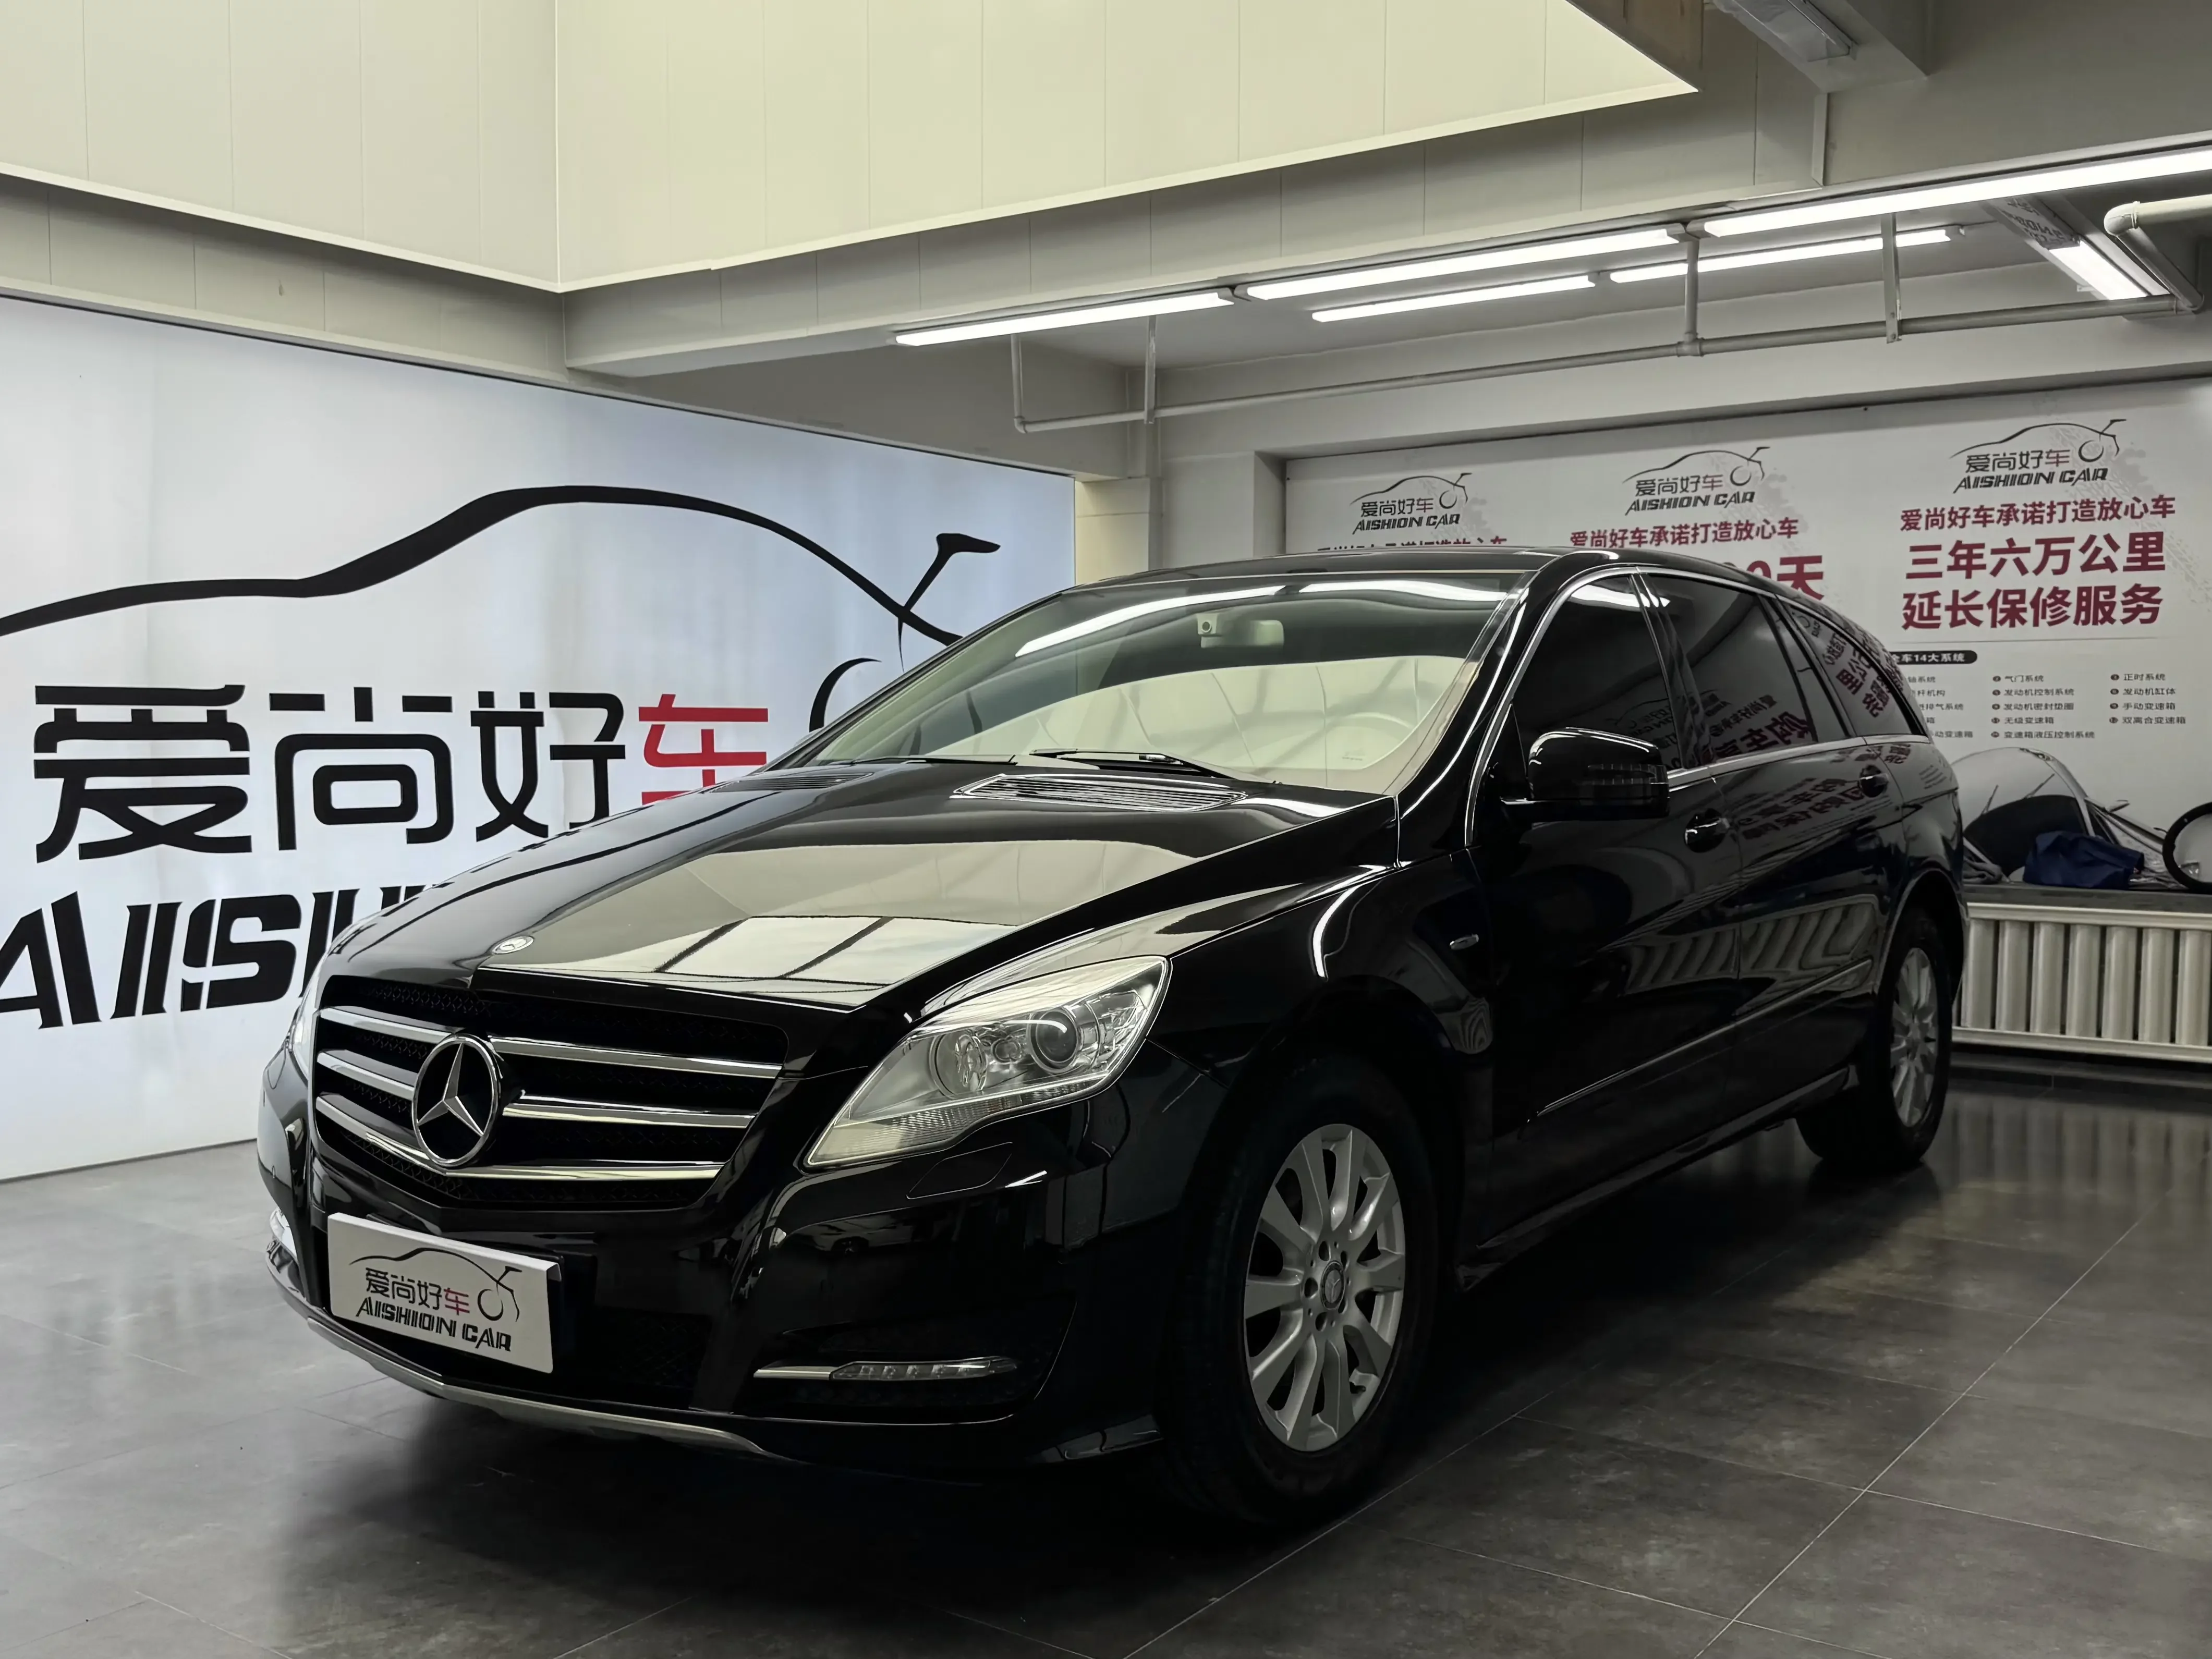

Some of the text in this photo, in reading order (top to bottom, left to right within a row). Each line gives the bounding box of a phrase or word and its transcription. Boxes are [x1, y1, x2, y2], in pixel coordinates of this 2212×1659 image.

[1966, 449, 2070, 473] 爱尚好车
[1635, 474, 1723, 497] 爱尚好车
[1953, 468, 2108, 494] AISHION CAR
[1361, 497, 1434, 517] 爱尚好车
[1625, 491, 1756, 516] AISHION CAR
[1900, 494, 2175, 532] 爱尚好车承诺打造放心车
[1352, 513, 1461, 534] AISHION CAR
[1570, 517, 1799, 548] 爱尚好车承诺打造放心车
[1905, 531, 2166, 579] 三年六万公里
[1902, 583, 2163, 631] 延长保修服务
[2003, 688, 2074, 697] 发动机控制系统
[34, 684, 769, 863] 爱尚好车
[365, 1267, 470, 1316] 爱尚好车
[356, 1296, 512, 1352] AISHION CAR
